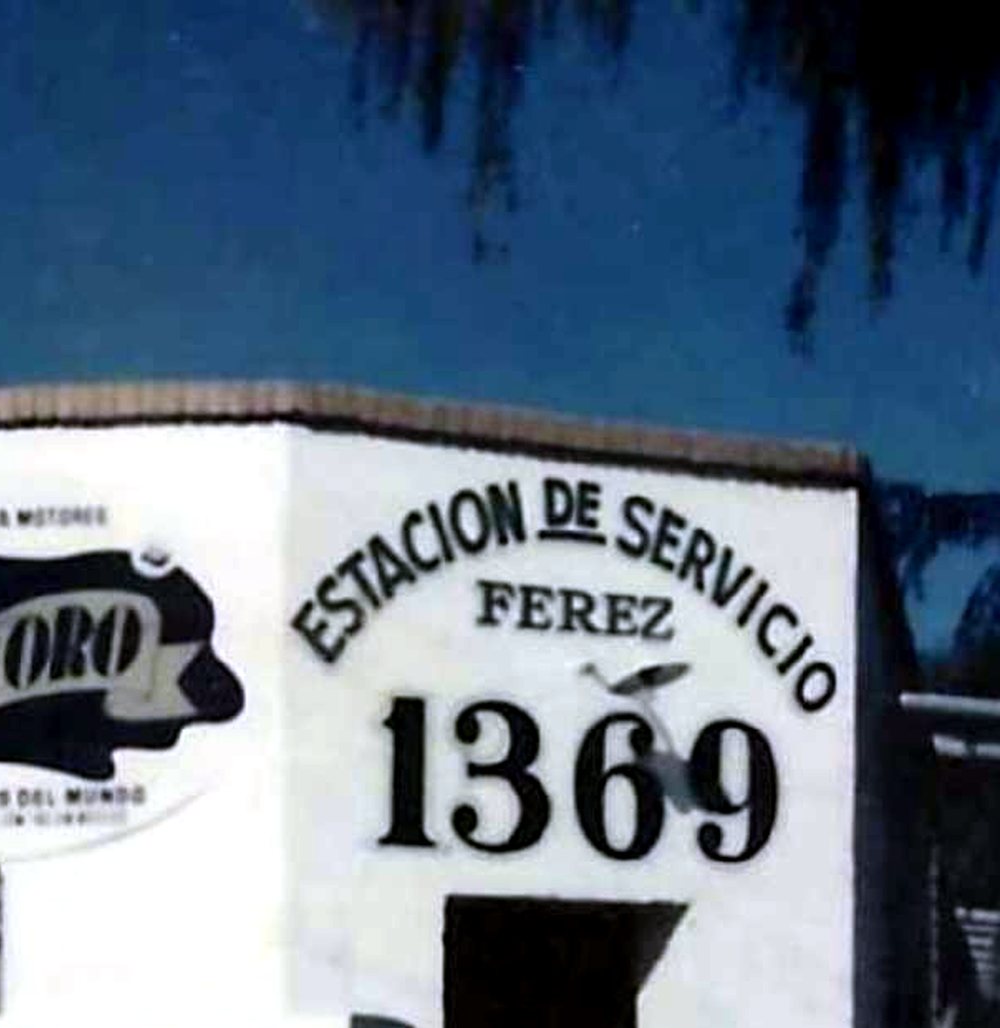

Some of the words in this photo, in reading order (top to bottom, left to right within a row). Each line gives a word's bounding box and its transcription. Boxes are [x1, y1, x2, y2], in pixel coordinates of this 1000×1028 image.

[15, 504, 109, 529] MOTORES
[292, 478, 527, 664] ESTACION
[540, 476, 606, 531] DE
[616, 495, 838, 714] SERVICIO
[475, 579, 677, 642] FEREZ
[3, 602, 144, 692] ORO
[16, 788, 56, 810] DEL
[63, 785, 146, 808] MUNDO
[376, 693, 780, 864] 1369
